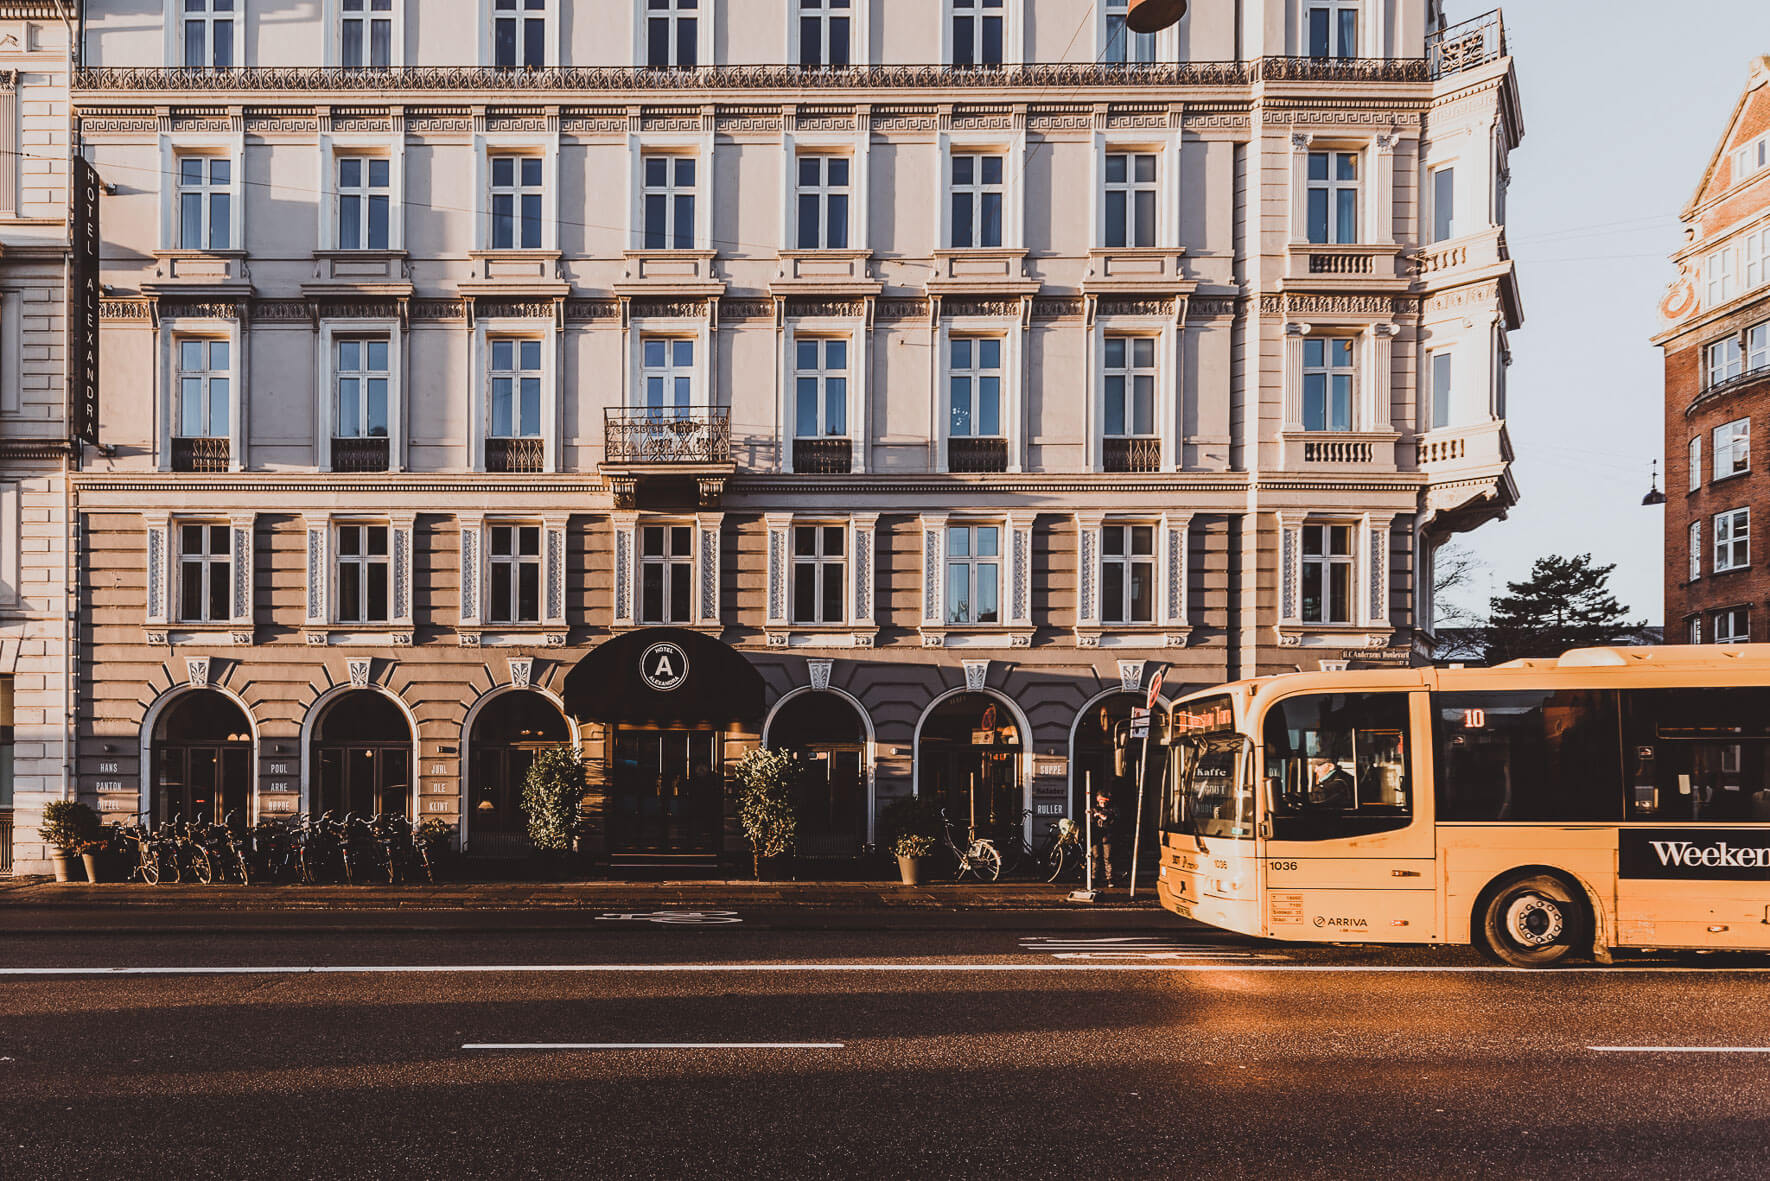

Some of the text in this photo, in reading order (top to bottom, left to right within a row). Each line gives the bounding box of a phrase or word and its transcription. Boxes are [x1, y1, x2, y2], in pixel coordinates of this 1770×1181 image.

[86, 279, 94, 435] ALEXANDRA
[655, 656, 673, 676] A
[1464, 708, 1485, 728] 10
[100, 763, 118, 773] HANS
[270, 764, 288, 774] POUL
[1196, 768, 1227, 777] Kaffe
[96, 781, 122, 792] PANTON
[270, 782, 288, 792] ARNE
[1037, 804, 1063, 815] RULLER
[1648, 841, 1770, 867] Weeken
[1270, 861, 1298, 871] 1036
[1327, 917, 1368, 927] ARRIVA
